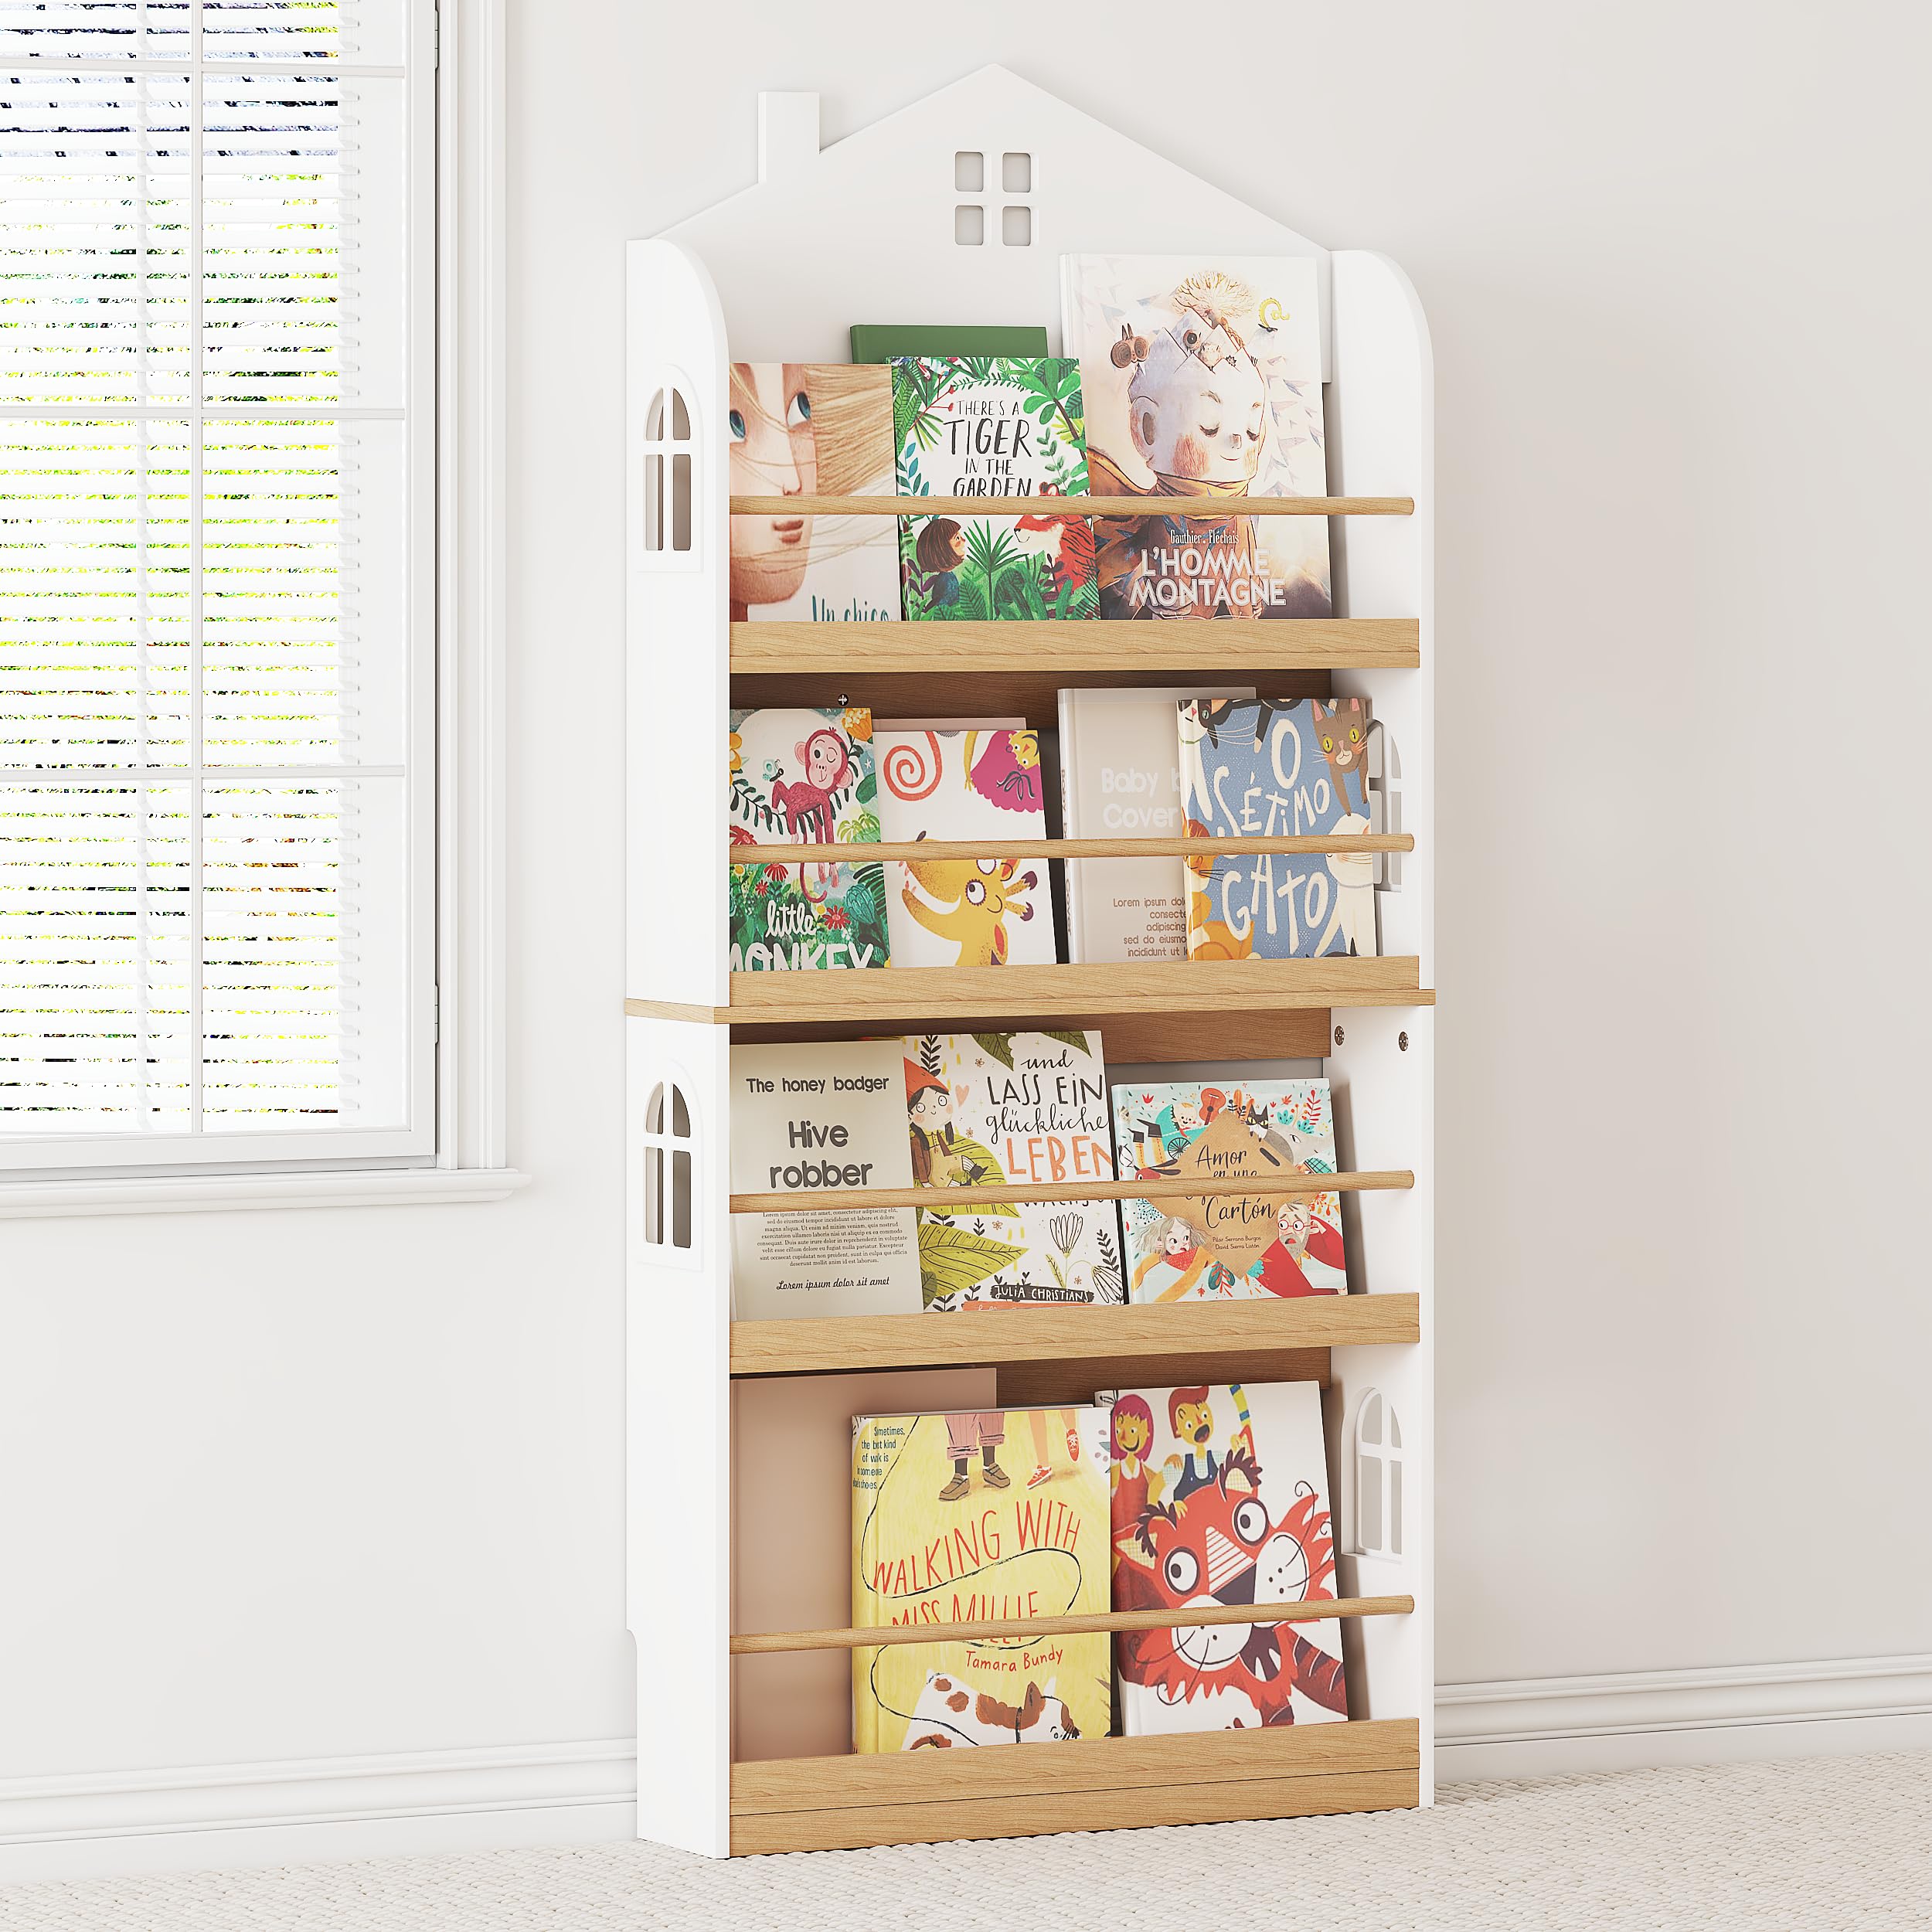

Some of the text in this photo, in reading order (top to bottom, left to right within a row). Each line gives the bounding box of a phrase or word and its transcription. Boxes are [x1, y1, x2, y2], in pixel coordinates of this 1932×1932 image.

[957, 400, 1019, 416] THERE'S A
[943, 418, 1032, 457] TIGER
[965, 457, 1013, 474] IN THE
[953, 477, 1032, 496] GARDEN
[1209, 528, 1240, 544] Fléchais
[1141, 546, 1270, 583] L'HOMME
[1129, 579, 1287, 607] MONTAGNE
[1270, 718, 1301, 790] O
[1101, 767, 1158, 798] Baby
[1103, 803, 1179, 828] Cover
[1113, 898, 1140, 907] Lorem
[1144, 897, 1166, 908] ipsum
[1222, 854, 1328, 955] GATO
[765, 900, 817, 937] little
[1146, 922, 1186, 933] adipiscing
[1124, 935, 1139, 944] sed
[1143, 935, 1155, 944] do
[1128, 947, 1167, 957] incididunt
[1170, 947, 1180, 956] ut
[1021, 1049, 1073, 1070] und
[746, 1076, 889, 1094] The honey badger
[788, 1120, 849, 1148] Hive
[1195, 1144, 1247, 1171] Amor
[770, 1159, 873, 1189] robber
[1206, 1196, 1277, 1229] Cartón
[777, 1277, 889, 1291] Lorem ipsum dolor sit amet
[862, 1440, 870, 1450] the
[883, 1439, 896, 1449] kind
[862, 1453, 869, 1463] of
[883, 1453, 889, 1463] is
[872, 1498, 1082, 1595] WALKING WITH
[966, 1644, 1063, 1672] Tamara Bundy
